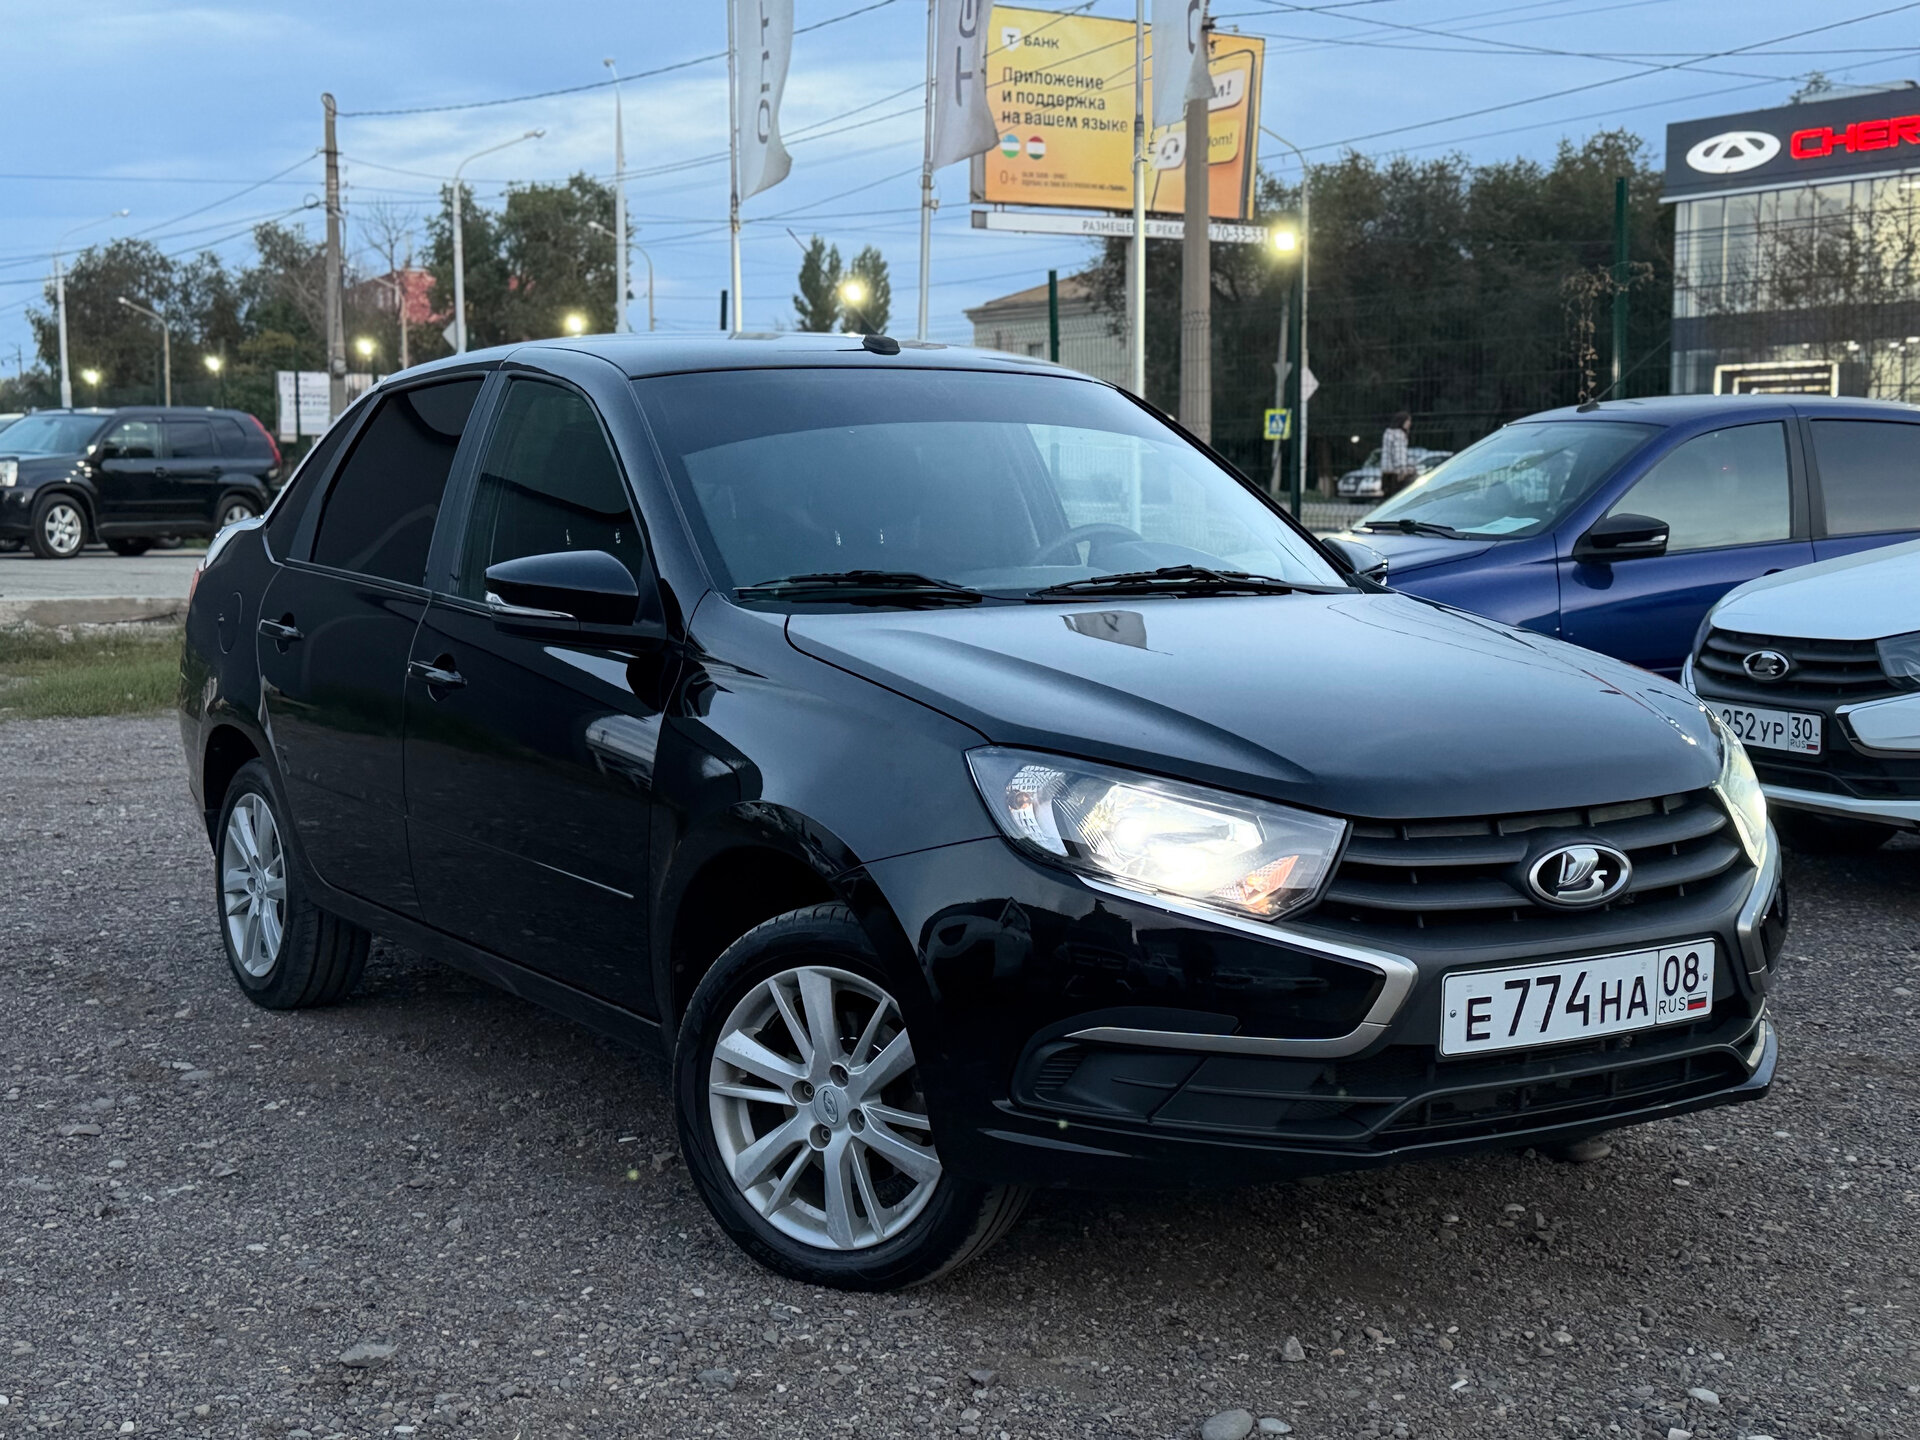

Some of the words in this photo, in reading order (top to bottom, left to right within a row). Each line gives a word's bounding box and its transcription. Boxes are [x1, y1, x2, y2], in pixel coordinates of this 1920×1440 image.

[1023, 35, 1060, 49] БАНК
[1003, 66, 1104, 90] Приложение
[1002, 90, 1012, 103] и
[1016, 91, 1106, 111] поддержка
[1002, 111, 1021, 125] на
[1024, 112, 1078, 129] вашем
[1082, 116, 1129, 133] языке
[999, 169, 1018, 186] 0+
[1082, 220, 1151, 236] РАЗМЕЩЕЕ
[1791, 716, 1813, 741] 30
[1789, 738, 1807, 750] RUS
[1663, 951, 1700, 997] 08
[1658, 996, 1687, 1016] RUS
